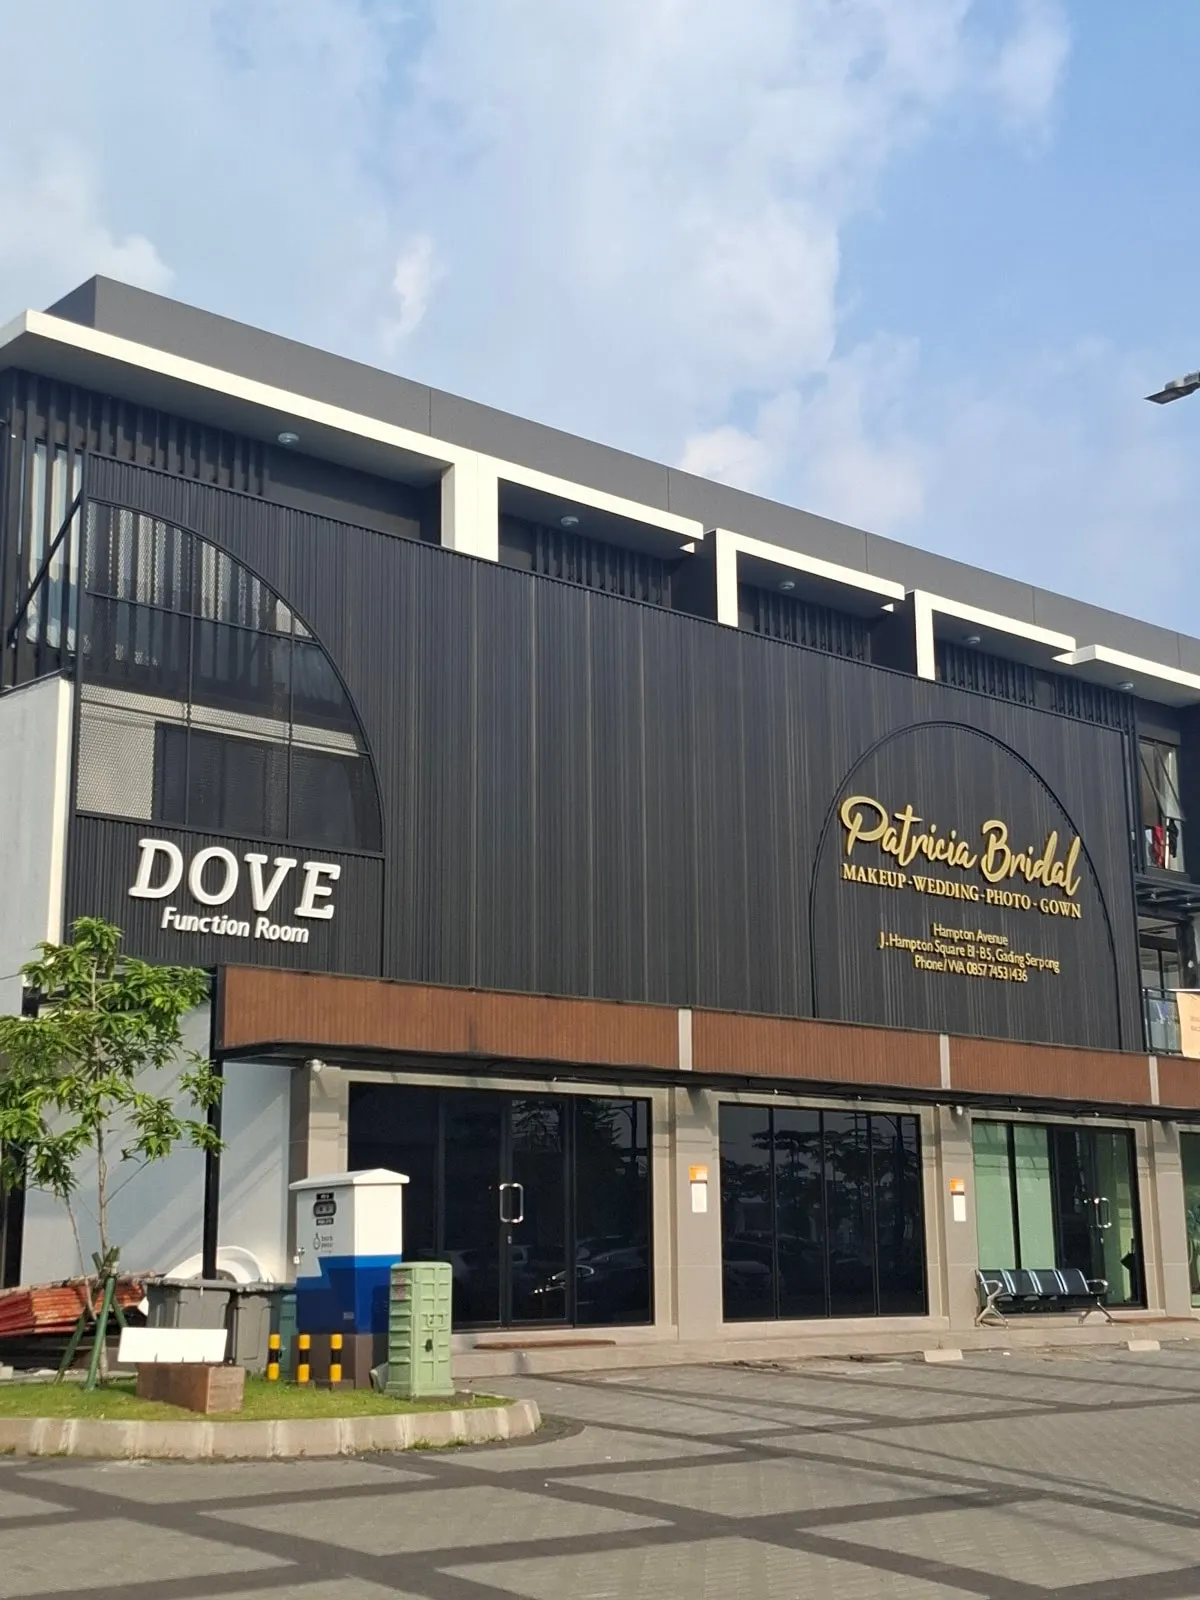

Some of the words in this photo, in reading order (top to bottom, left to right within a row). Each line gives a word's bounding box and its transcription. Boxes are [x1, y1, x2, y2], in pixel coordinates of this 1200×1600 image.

[841, 795, 978, 867] Patricia
[981, 819, 1082, 897] Bridal
[128, 838, 341, 920] DOVE
[842, 863, 907, 889] MAKEUP
[912, 875, 979, 901] WEDDING
[986, 888, 1031, 910] PHOTO
[1040, 899, 1082, 919] GOWN
[160, 906, 250, 938] Function
[254, 916, 310, 944] Room
[933, 923, 975, 943] Hampton
[976, 929, 1008, 946] Avenue
[934, 940, 966, 958] Square
[995, 948, 1026, 968] Gading
[1025, 952, 1060, 974] Serpong
[966, 961, 987, 976] 0857
[988, 964, 1008, 979] 7453
[1009, 967, 1028, 982] 1436
